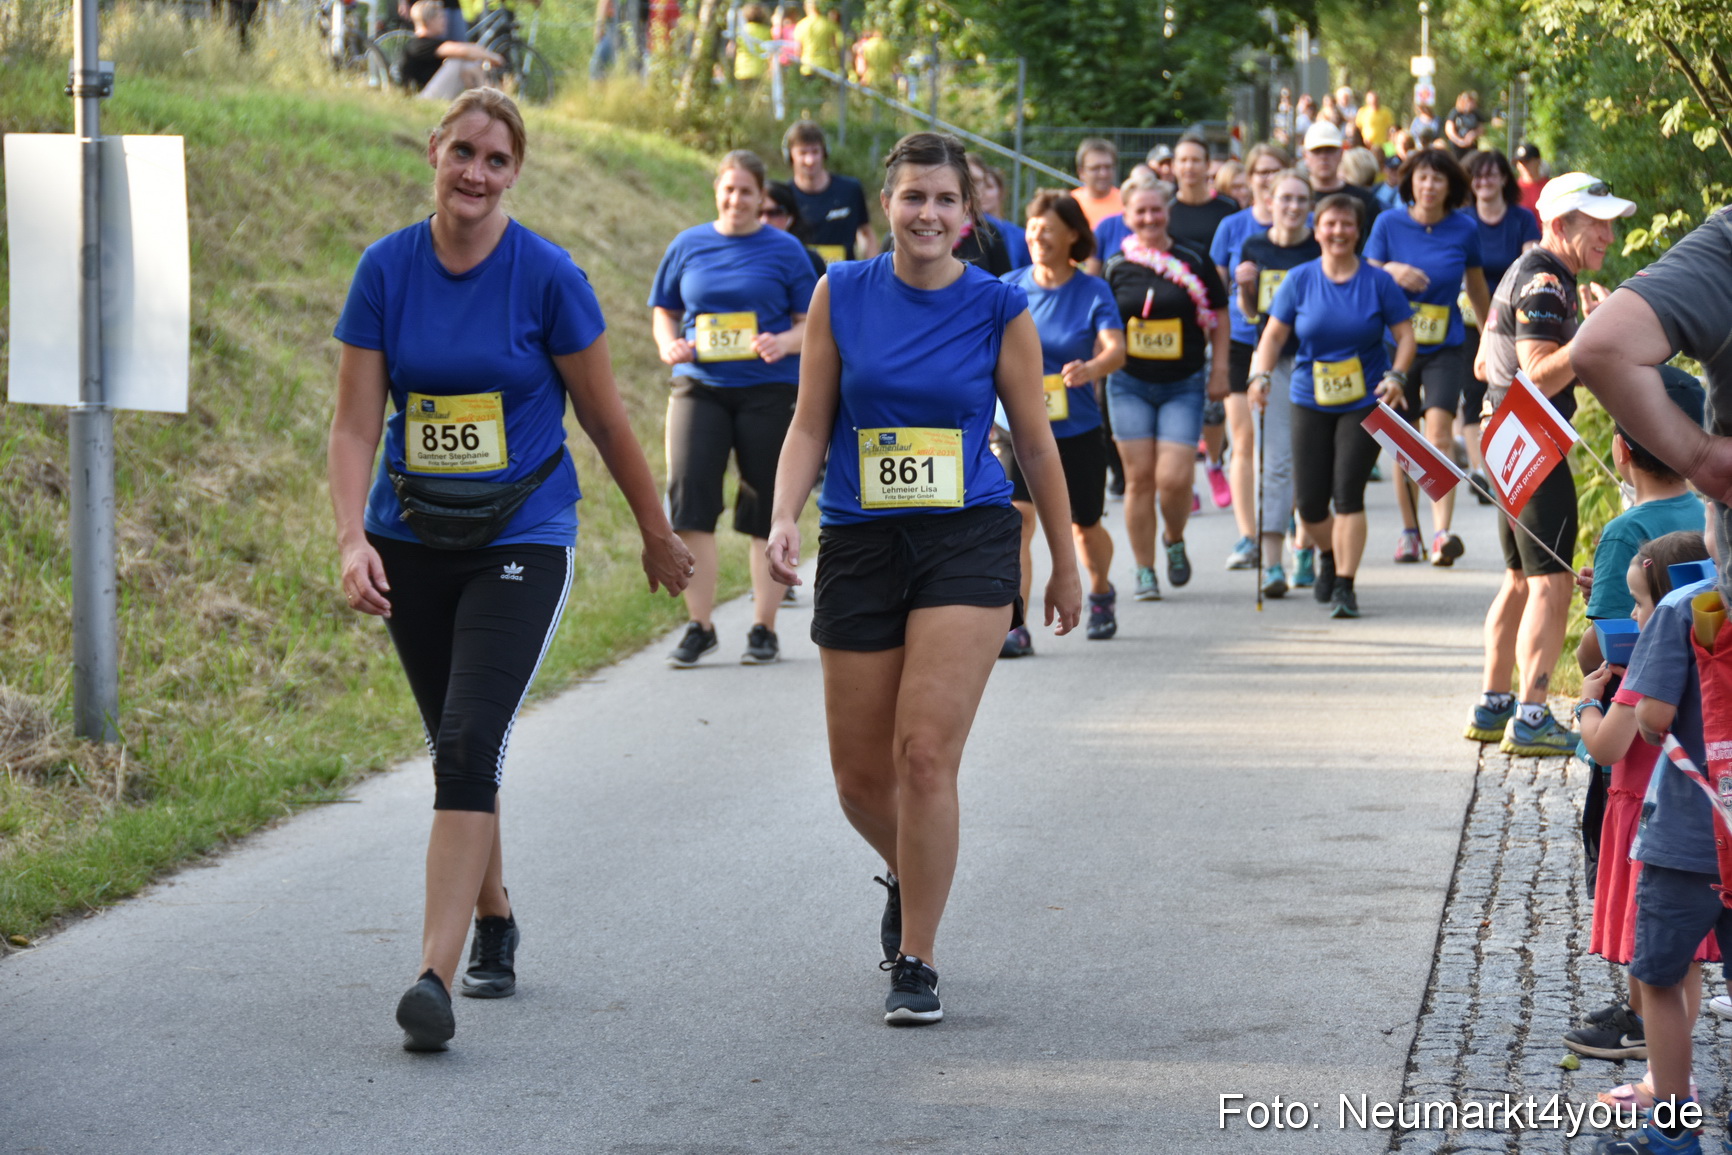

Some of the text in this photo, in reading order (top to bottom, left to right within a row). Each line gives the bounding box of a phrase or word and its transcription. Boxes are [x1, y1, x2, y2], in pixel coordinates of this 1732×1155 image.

[709, 329, 741, 347] 857
[1135, 332, 1174, 348] 1649
[1323, 375, 1352, 393] 854
[422, 423, 480, 452] 856
[417, 450, 490, 461] Gantner Stephanie
[879, 456, 934, 486] 861
[1508, 454, 1547, 505] DEHN protects.
[882, 485, 938, 494] Lehmeier Lisa
[500, 573, 523, 581] adidas
